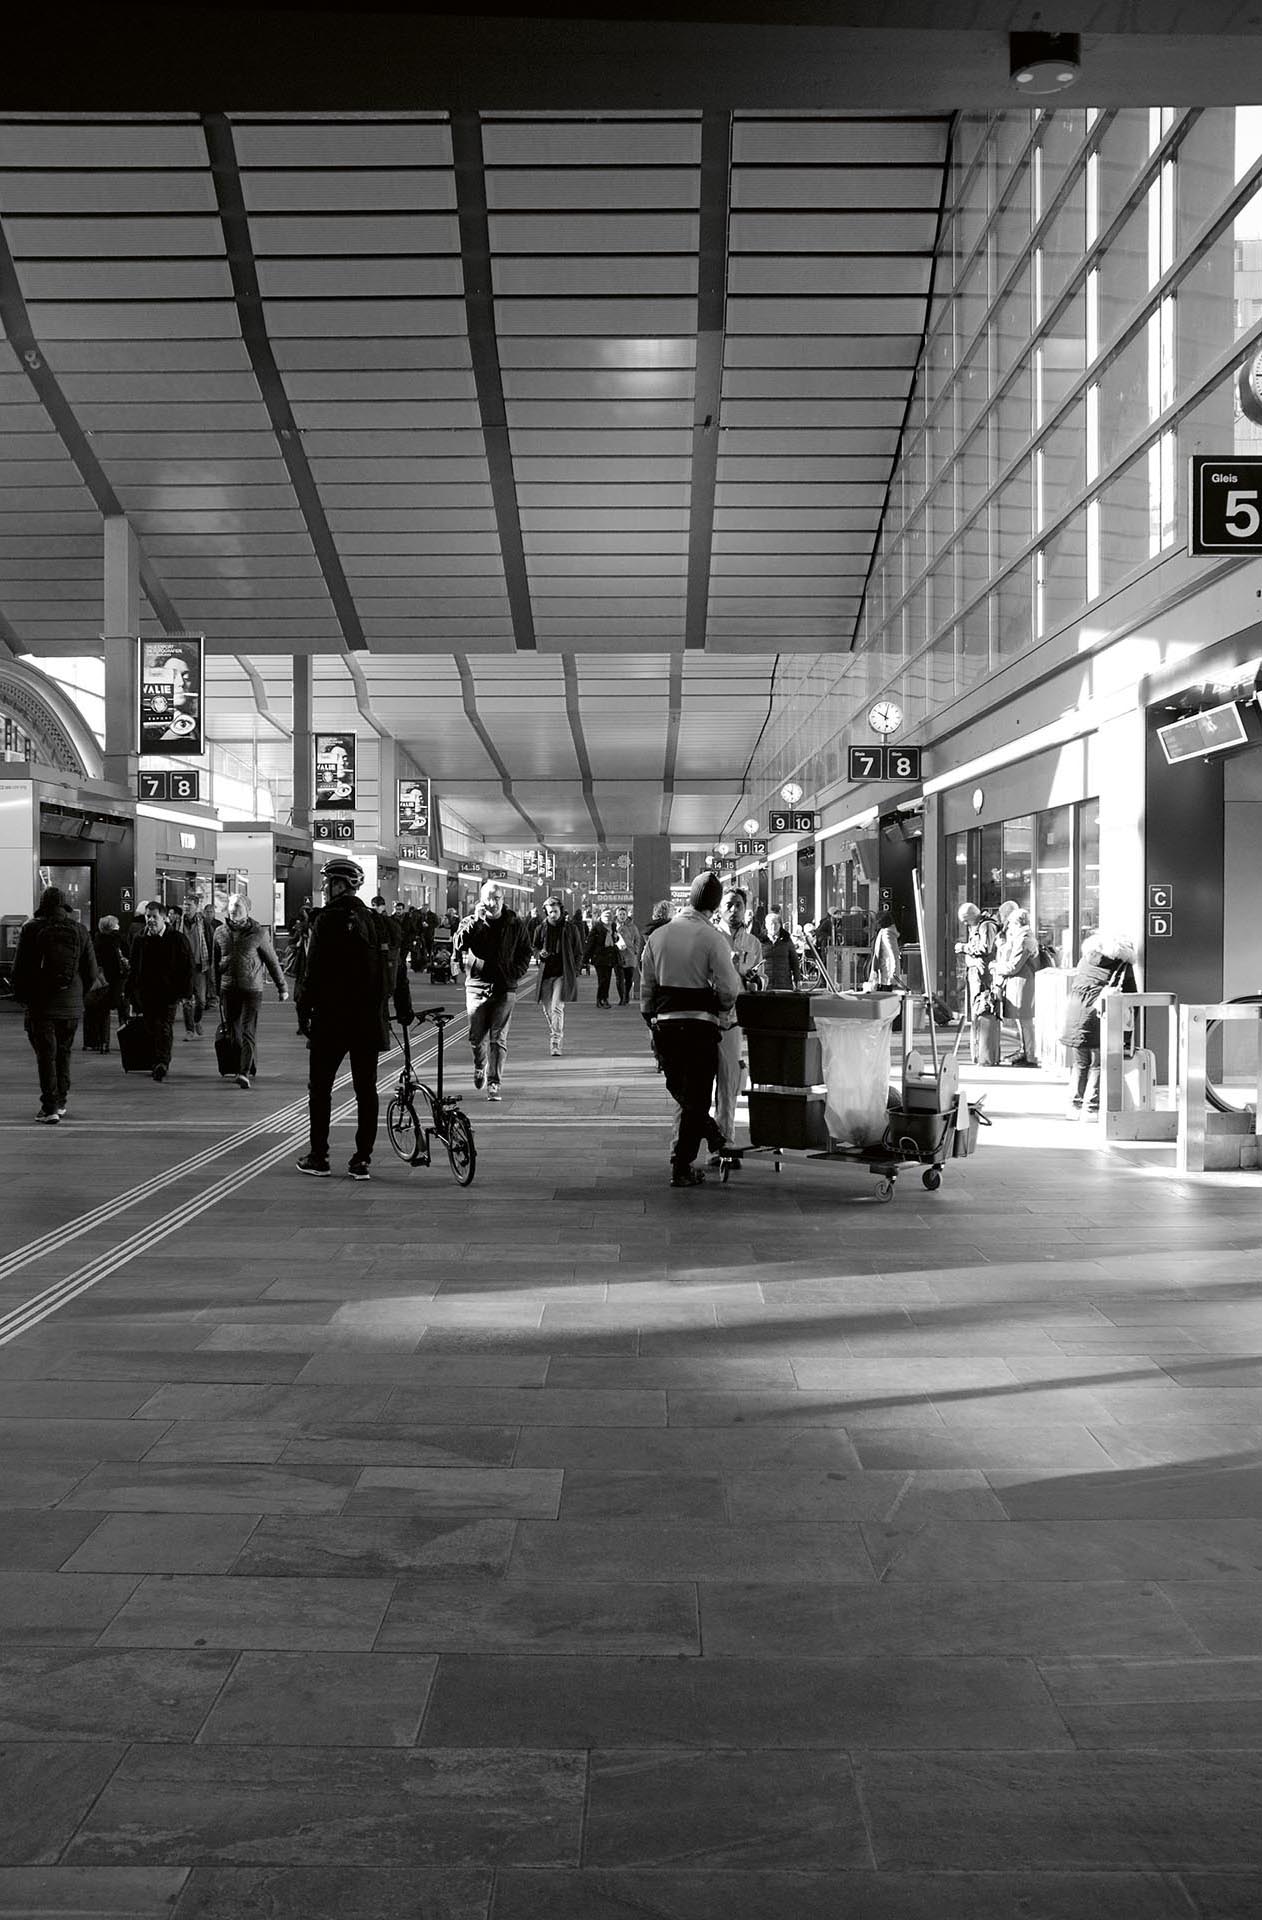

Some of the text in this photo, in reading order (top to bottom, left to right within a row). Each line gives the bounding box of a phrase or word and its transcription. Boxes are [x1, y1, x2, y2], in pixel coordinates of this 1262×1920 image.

[1211, 473, 1238, 483] Gleis
[1225, 490, 1260, 538] 5
[143, 684, 171, 694] VALIE
[860, 757, 911, 776] 7 8
[147, 780, 190, 796] 7 8
[776, 818, 811, 830] 9 10
[320, 826, 351, 837] 9 10
[417, 849, 427, 858] 12
[738, 844, 765, 853] 11 12
[713, 861, 735, 869] 14 15
[570, 881, 628, 890] OCHSNER
[883, 890, 889, 898] C
[1155, 891, 1167, 906] C
[883, 903, 889, 911] D
[1155, 919, 1167, 934] D
